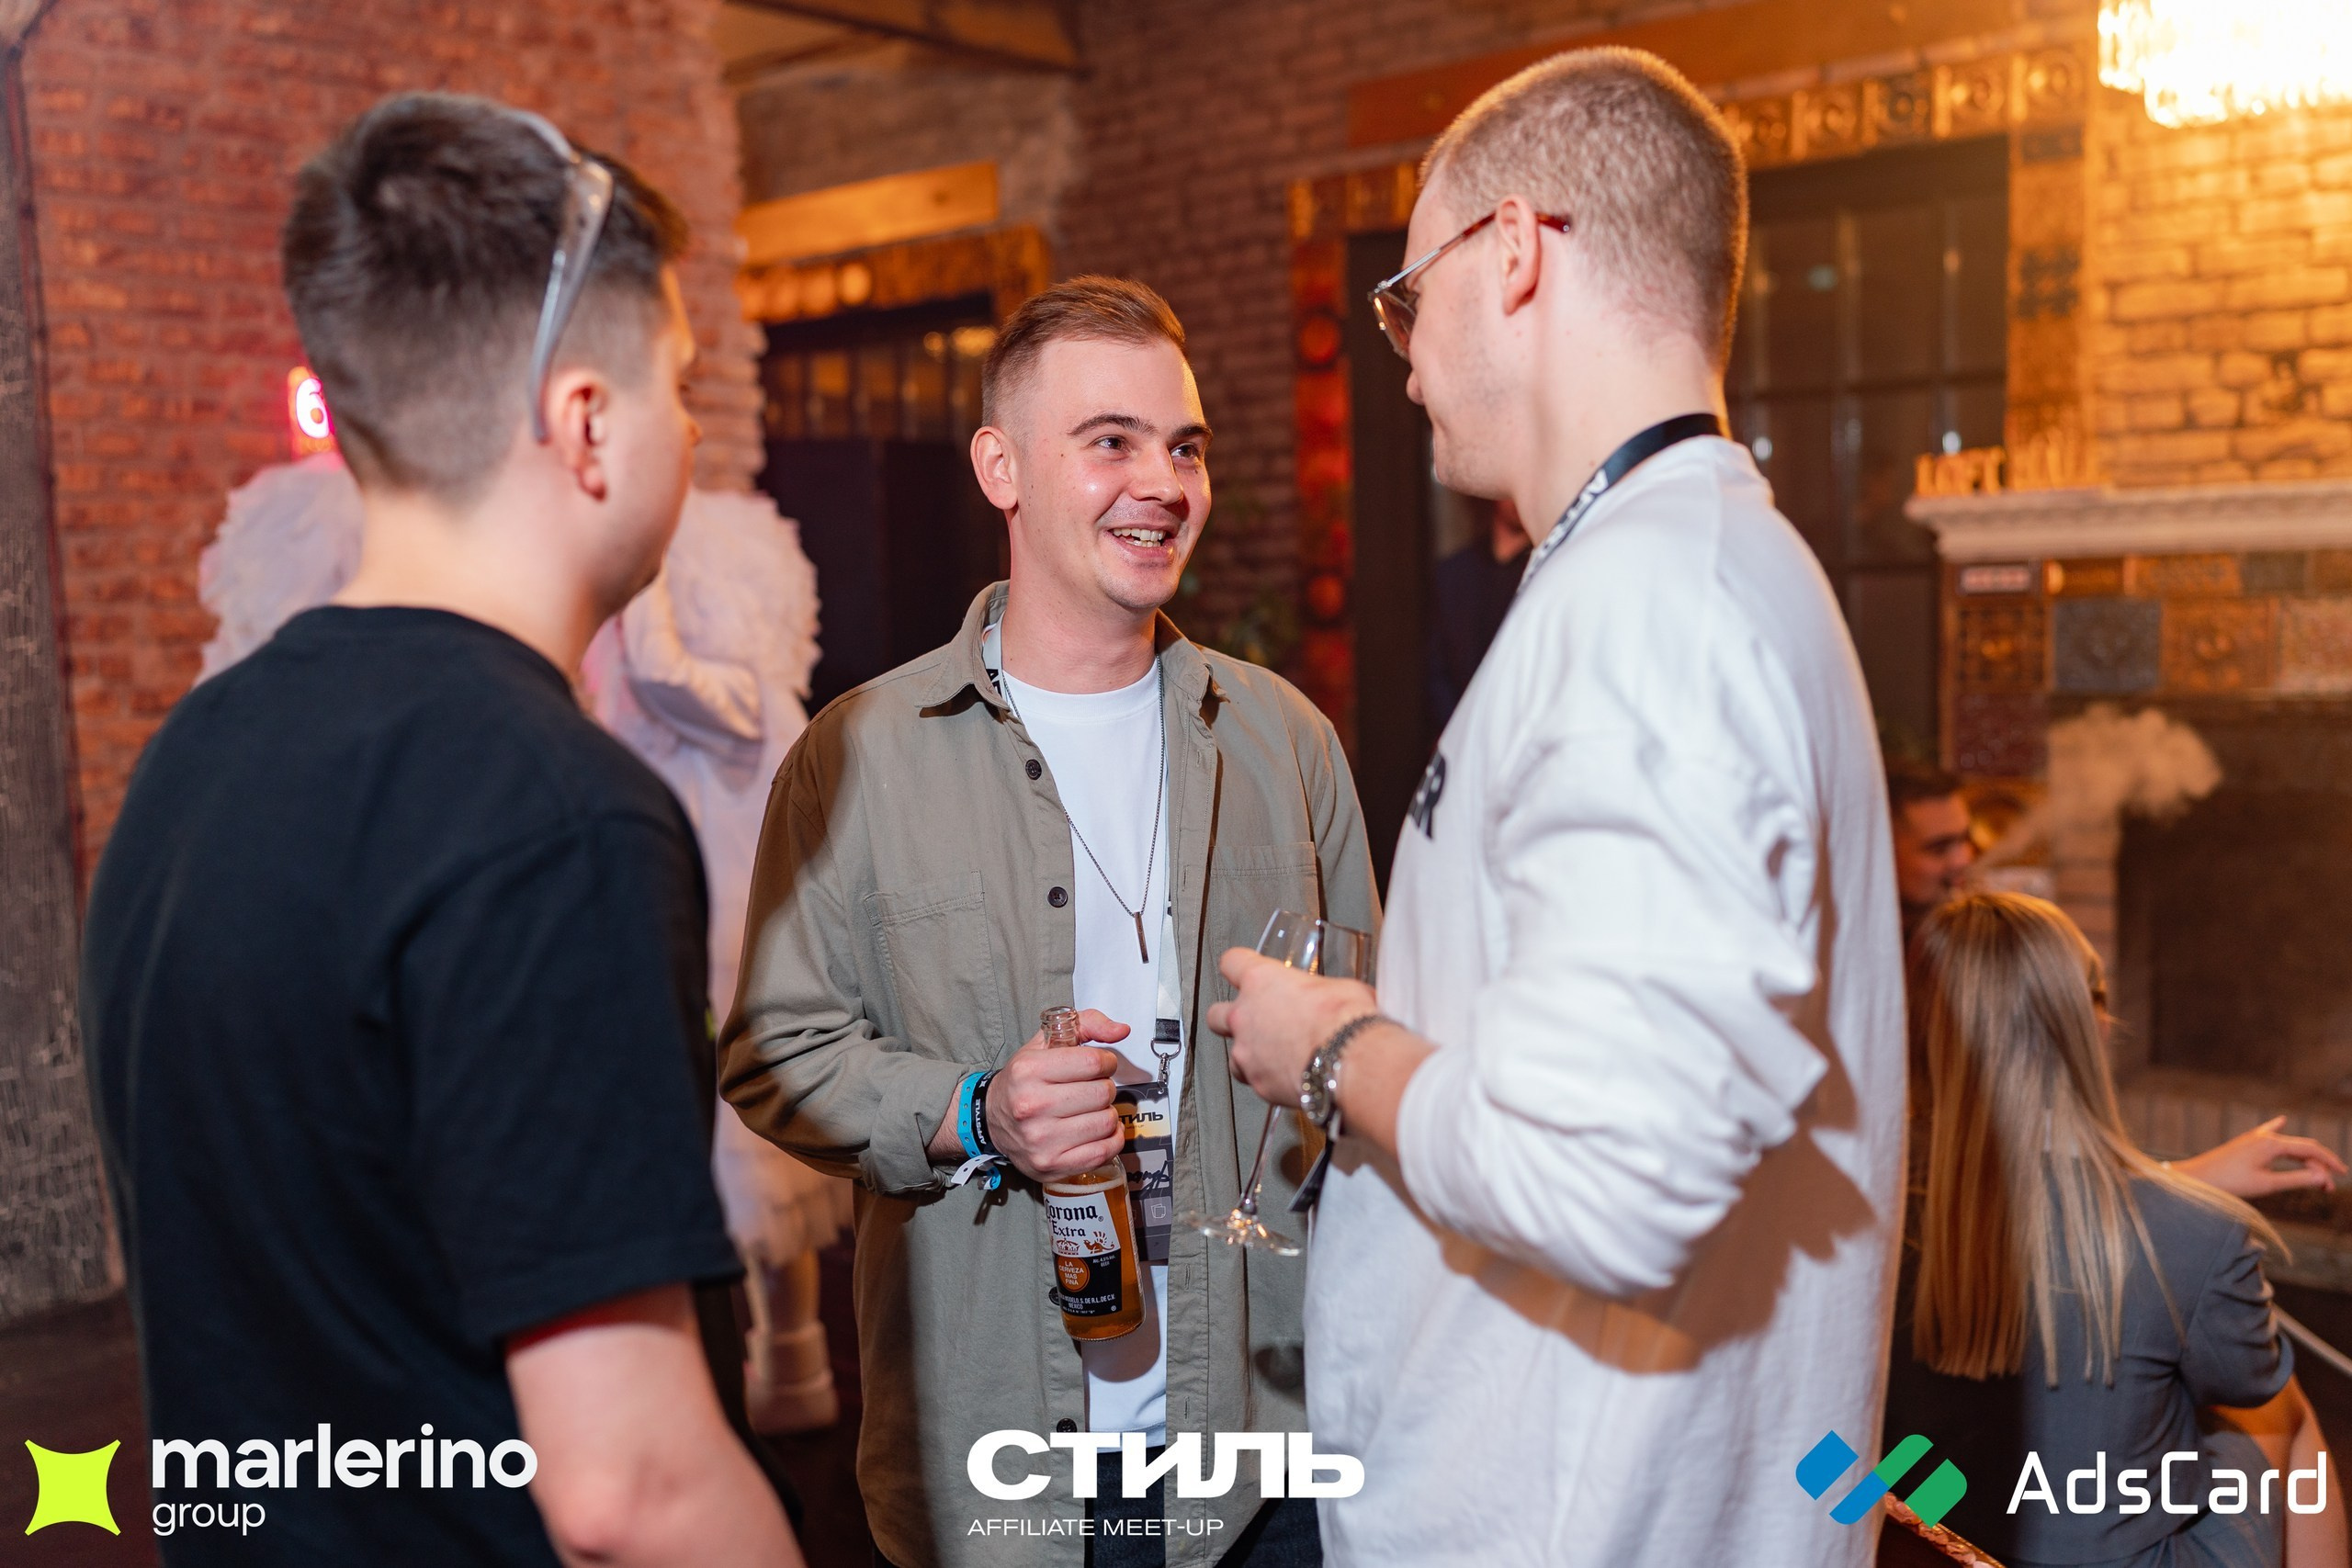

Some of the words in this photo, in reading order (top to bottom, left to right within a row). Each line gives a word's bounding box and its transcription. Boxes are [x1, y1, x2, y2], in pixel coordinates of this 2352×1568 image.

[295, 378, 330, 439] 6
[1118, 1111, 1164, 1125] ТИЛЬ
[1045, 1198, 1099, 1221] Corona
[1052, 1220, 1086, 1236] Extra
[1058, 1265, 1084, 1273] CERVEZA
